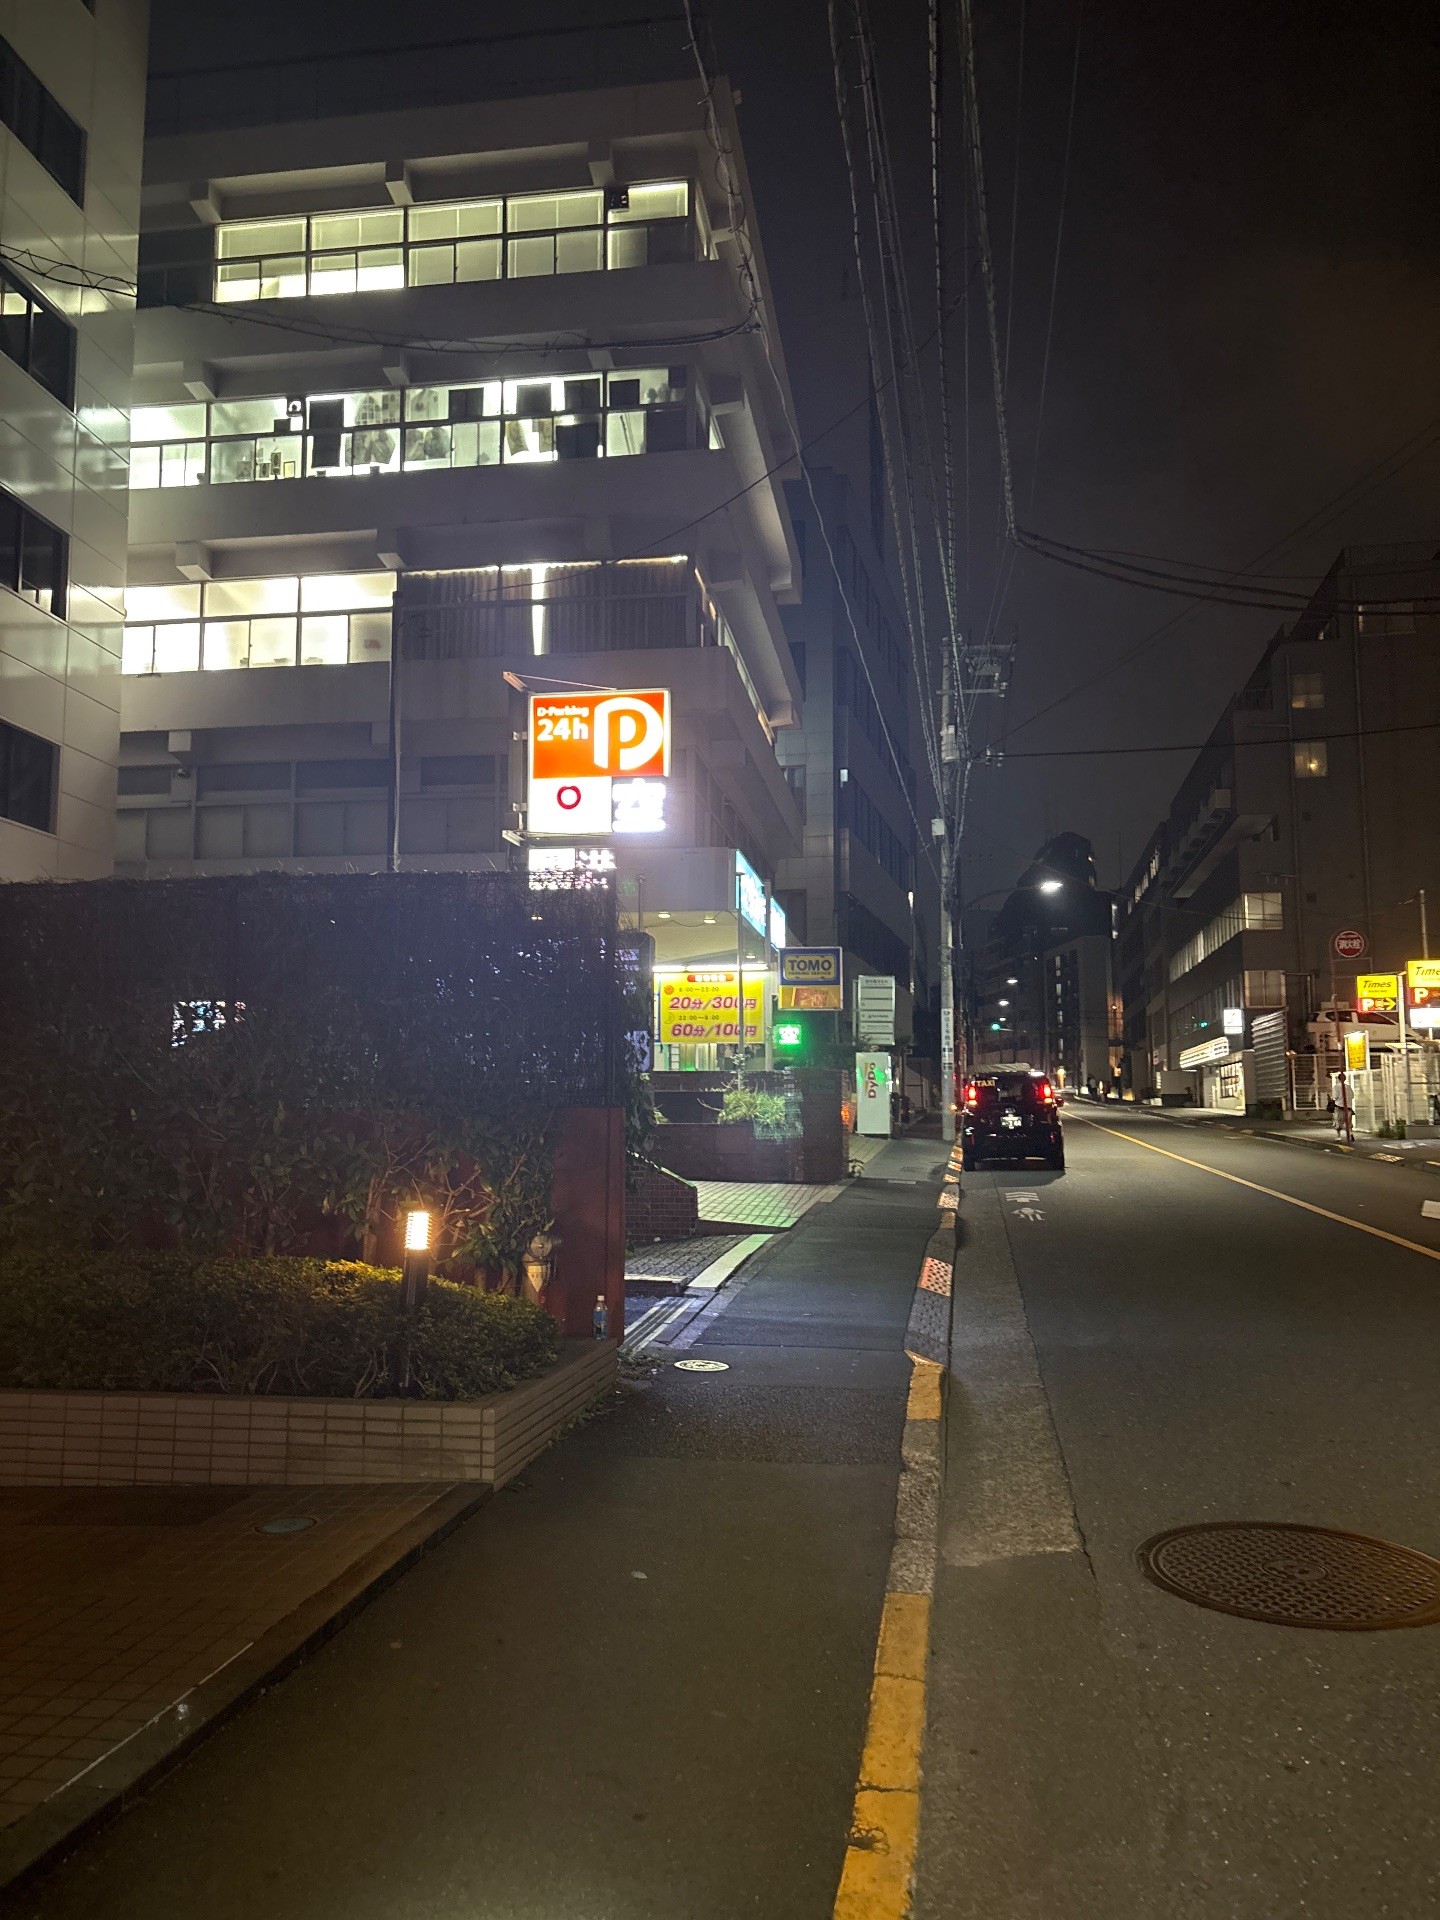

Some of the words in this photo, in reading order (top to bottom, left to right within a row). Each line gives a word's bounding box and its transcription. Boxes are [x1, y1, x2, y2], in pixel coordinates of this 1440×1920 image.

[537, 717, 588, 741] 24h
[601, 703, 655, 770] P
[1338, 939, 1361, 950] 消火栓
[788, 959, 832, 971] TOMO
[1363, 980, 1392, 989] Times
[1414, 987, 1429, 1004] P
[1362, 998, 1374, 1011] P
[867, 1062, 878, 1099] DyDo
[976, 1079, 995, 1088] TAXI
